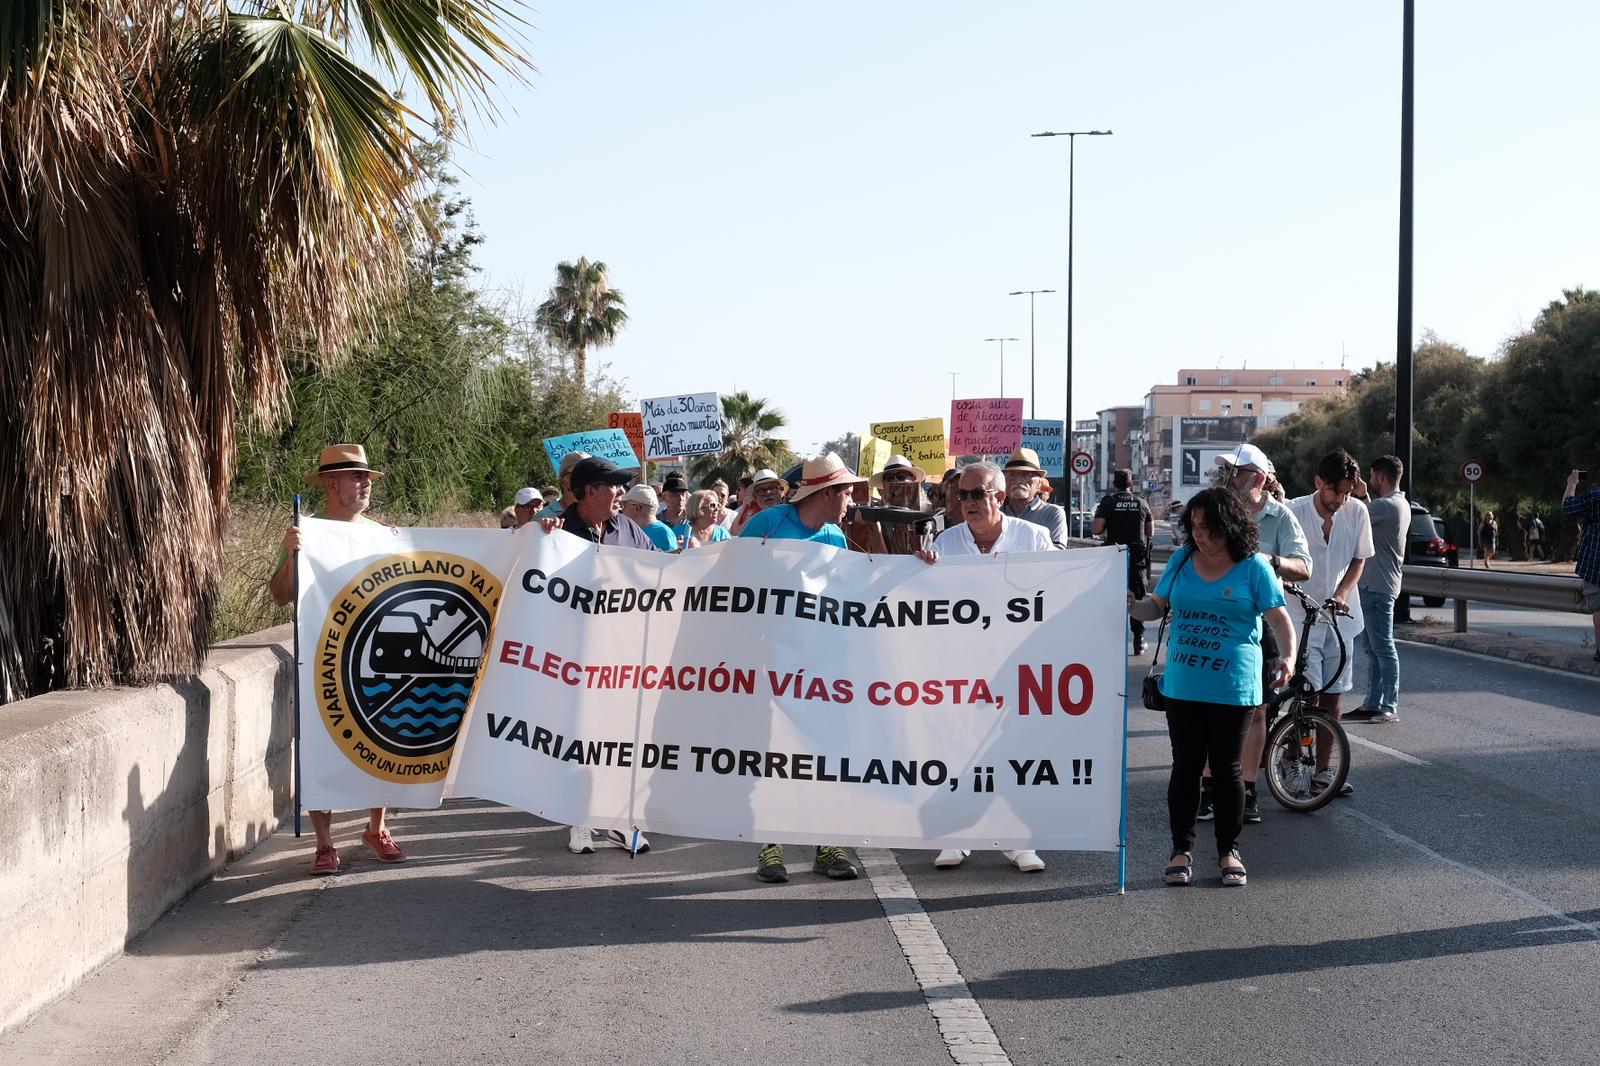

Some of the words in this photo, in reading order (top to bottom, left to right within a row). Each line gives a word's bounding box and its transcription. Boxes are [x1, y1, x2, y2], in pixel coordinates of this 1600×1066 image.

[643, 401, 665, 418] Más
[667, 400, 680, 414] de
[678, 397, 695, 412] 30
[695, 402, 718, 413] años
[610, 413, 619, 428] 8
[958, 410, 968, 422] de
[645, 420, 659, 435] de
[661, 420, 687, 433] vías
[688, 415, 720, 431] muertas
[873, 423, 915, 435] Corredor
[1044, 427, 1061, 436] MAR
[610, 432, 623, 441] de
[583, 442, 630, 453] GABRIEL
[648, 434, 673, 456] ADIF
[918, 449, 945, 461] bahía
[1466, 467, 1480, 476] 50
[522, 568, 677, 615] CORREDOR
[683, 586, 991, 630] MEDITERRÁNEO,
[1005, 590, 1045, 623] SÍ
[1177, 609, 1228, 625] JUNTOS
[322, 629, 345, 727] VARIANTE
[334, 599, 356, 627] DE
[351, 559, 465, 600] TORRELLANO
[469, 570, 494, 598] YA!
[1177, 635, 1221, 651] BARRIO
[499, 639, 756, 695] ELECTRIFICACIÓN
[768, 669, 854, 704] VÍAS
[867, 678, 1004, 709] COSTA,
[1018, 662, 1094, 716] NO
[353, 740, 377, 764] POR
[377, 756, 396, 773] UN
[397, 759, 447, 776] LITORAL
[486, 713, 634, 767] VARIANTE
[641, 743, 680, 771] DE
[690, 746, 959, 792] TORRELLANO,
[1008, 759, 1059, 786] YA
